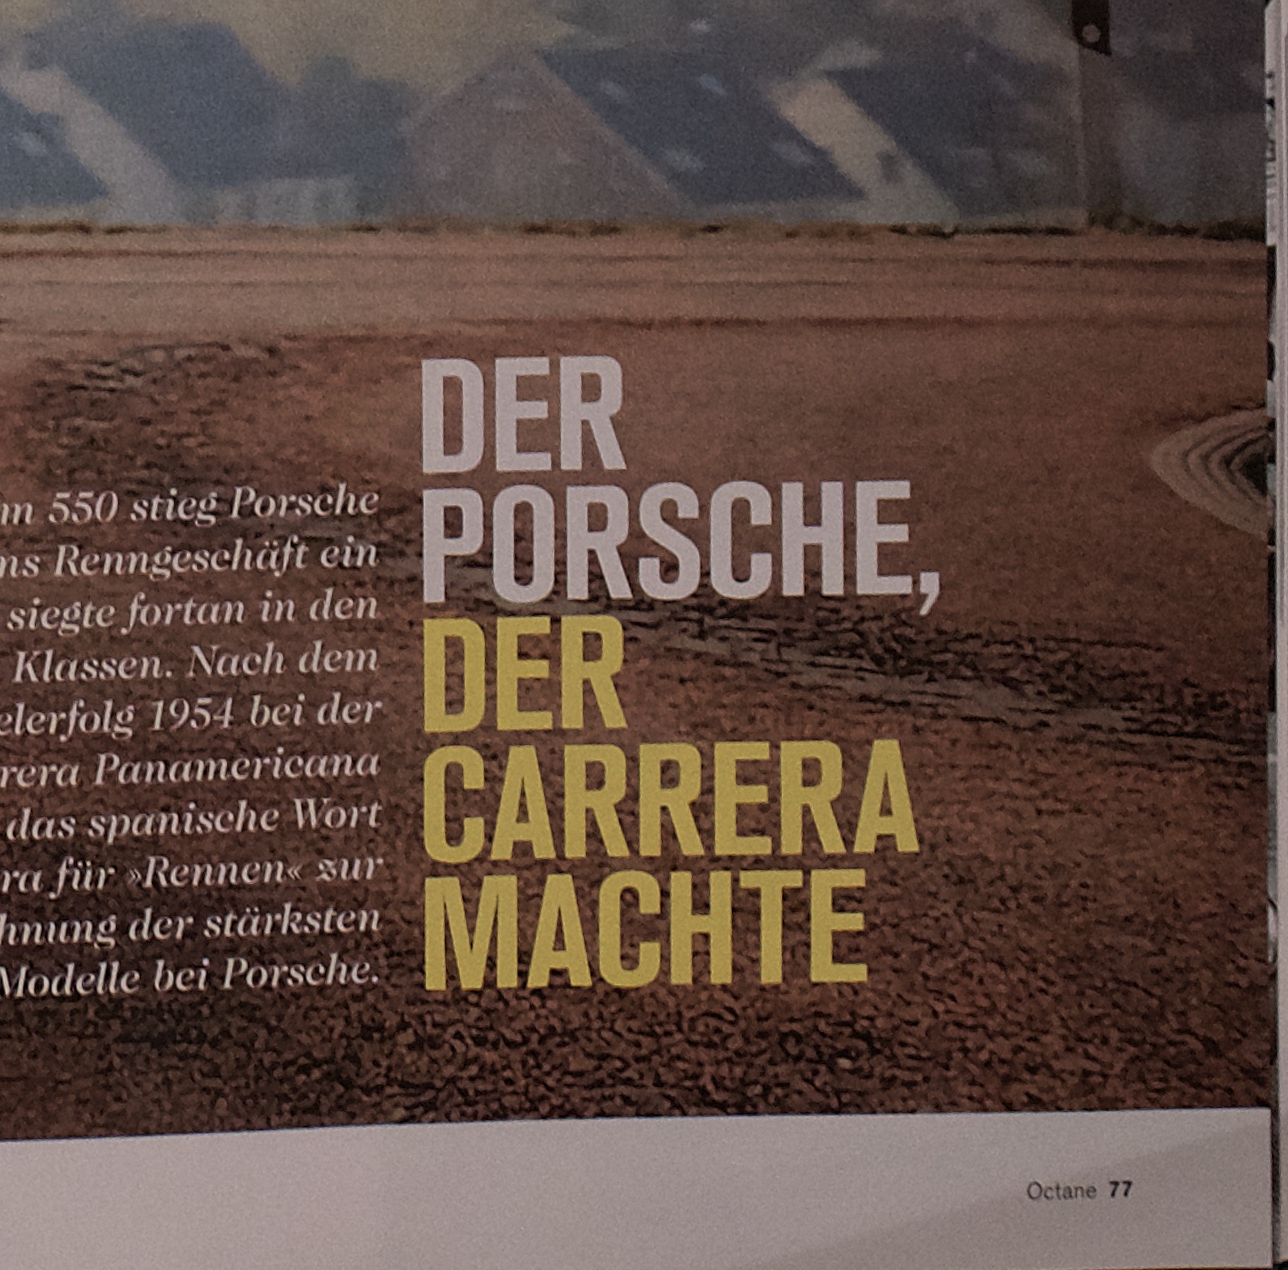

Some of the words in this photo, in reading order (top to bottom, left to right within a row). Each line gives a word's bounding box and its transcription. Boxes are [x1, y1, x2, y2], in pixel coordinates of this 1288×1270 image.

[422, 355, 626, 473] DER
[48, 490, 119, 523] 550
[130, 488, 217, 526] stieg
[230, 484, 379, 519] Porsche
[54, 537, 309, 580] Renngeschäft
[321, 536, 378, 568] ein
[422, 480, 941, 615] PORSCHE,
[7, 598, 115, 635] siegte
[121, 592, 245, 634] fortan
[260, 591, 295, 621] in
[309, 590, 378, 620] den
[12, 650, 173, 684] Klassen.
[186, 642, 285, 678] Nach
[298, 641, 379, 673] dem
[423, 615, 627, 732] DER
[150, 697, 235, 731] 1954
[250, 694, 304, 726] bei
[317, 692, 382, 724] der
[94, 745, 380, 786] Panamericana
[6, 808, 75, 840] das
[88, 798, 279, 844] spanische
[293, 797, 382, 829] Wort
[423, 739, 919, 863] CARRERA
[49, 857, 114, 899] für
[129, 855, 302, 889] »Rennen«
[317, 855, 383, 882] zur
[128, 908, 194, 941] der
[203, 901, 380, 939] stärksten
[423, 868, 868, 991] MACHTE
[153, 958, 209, 991] bei
[224, 953, 379, 989] Porsche.
[1027, 1181, 1096, 1200] Octane
[1109, 1181, 1132, 1198] 77
